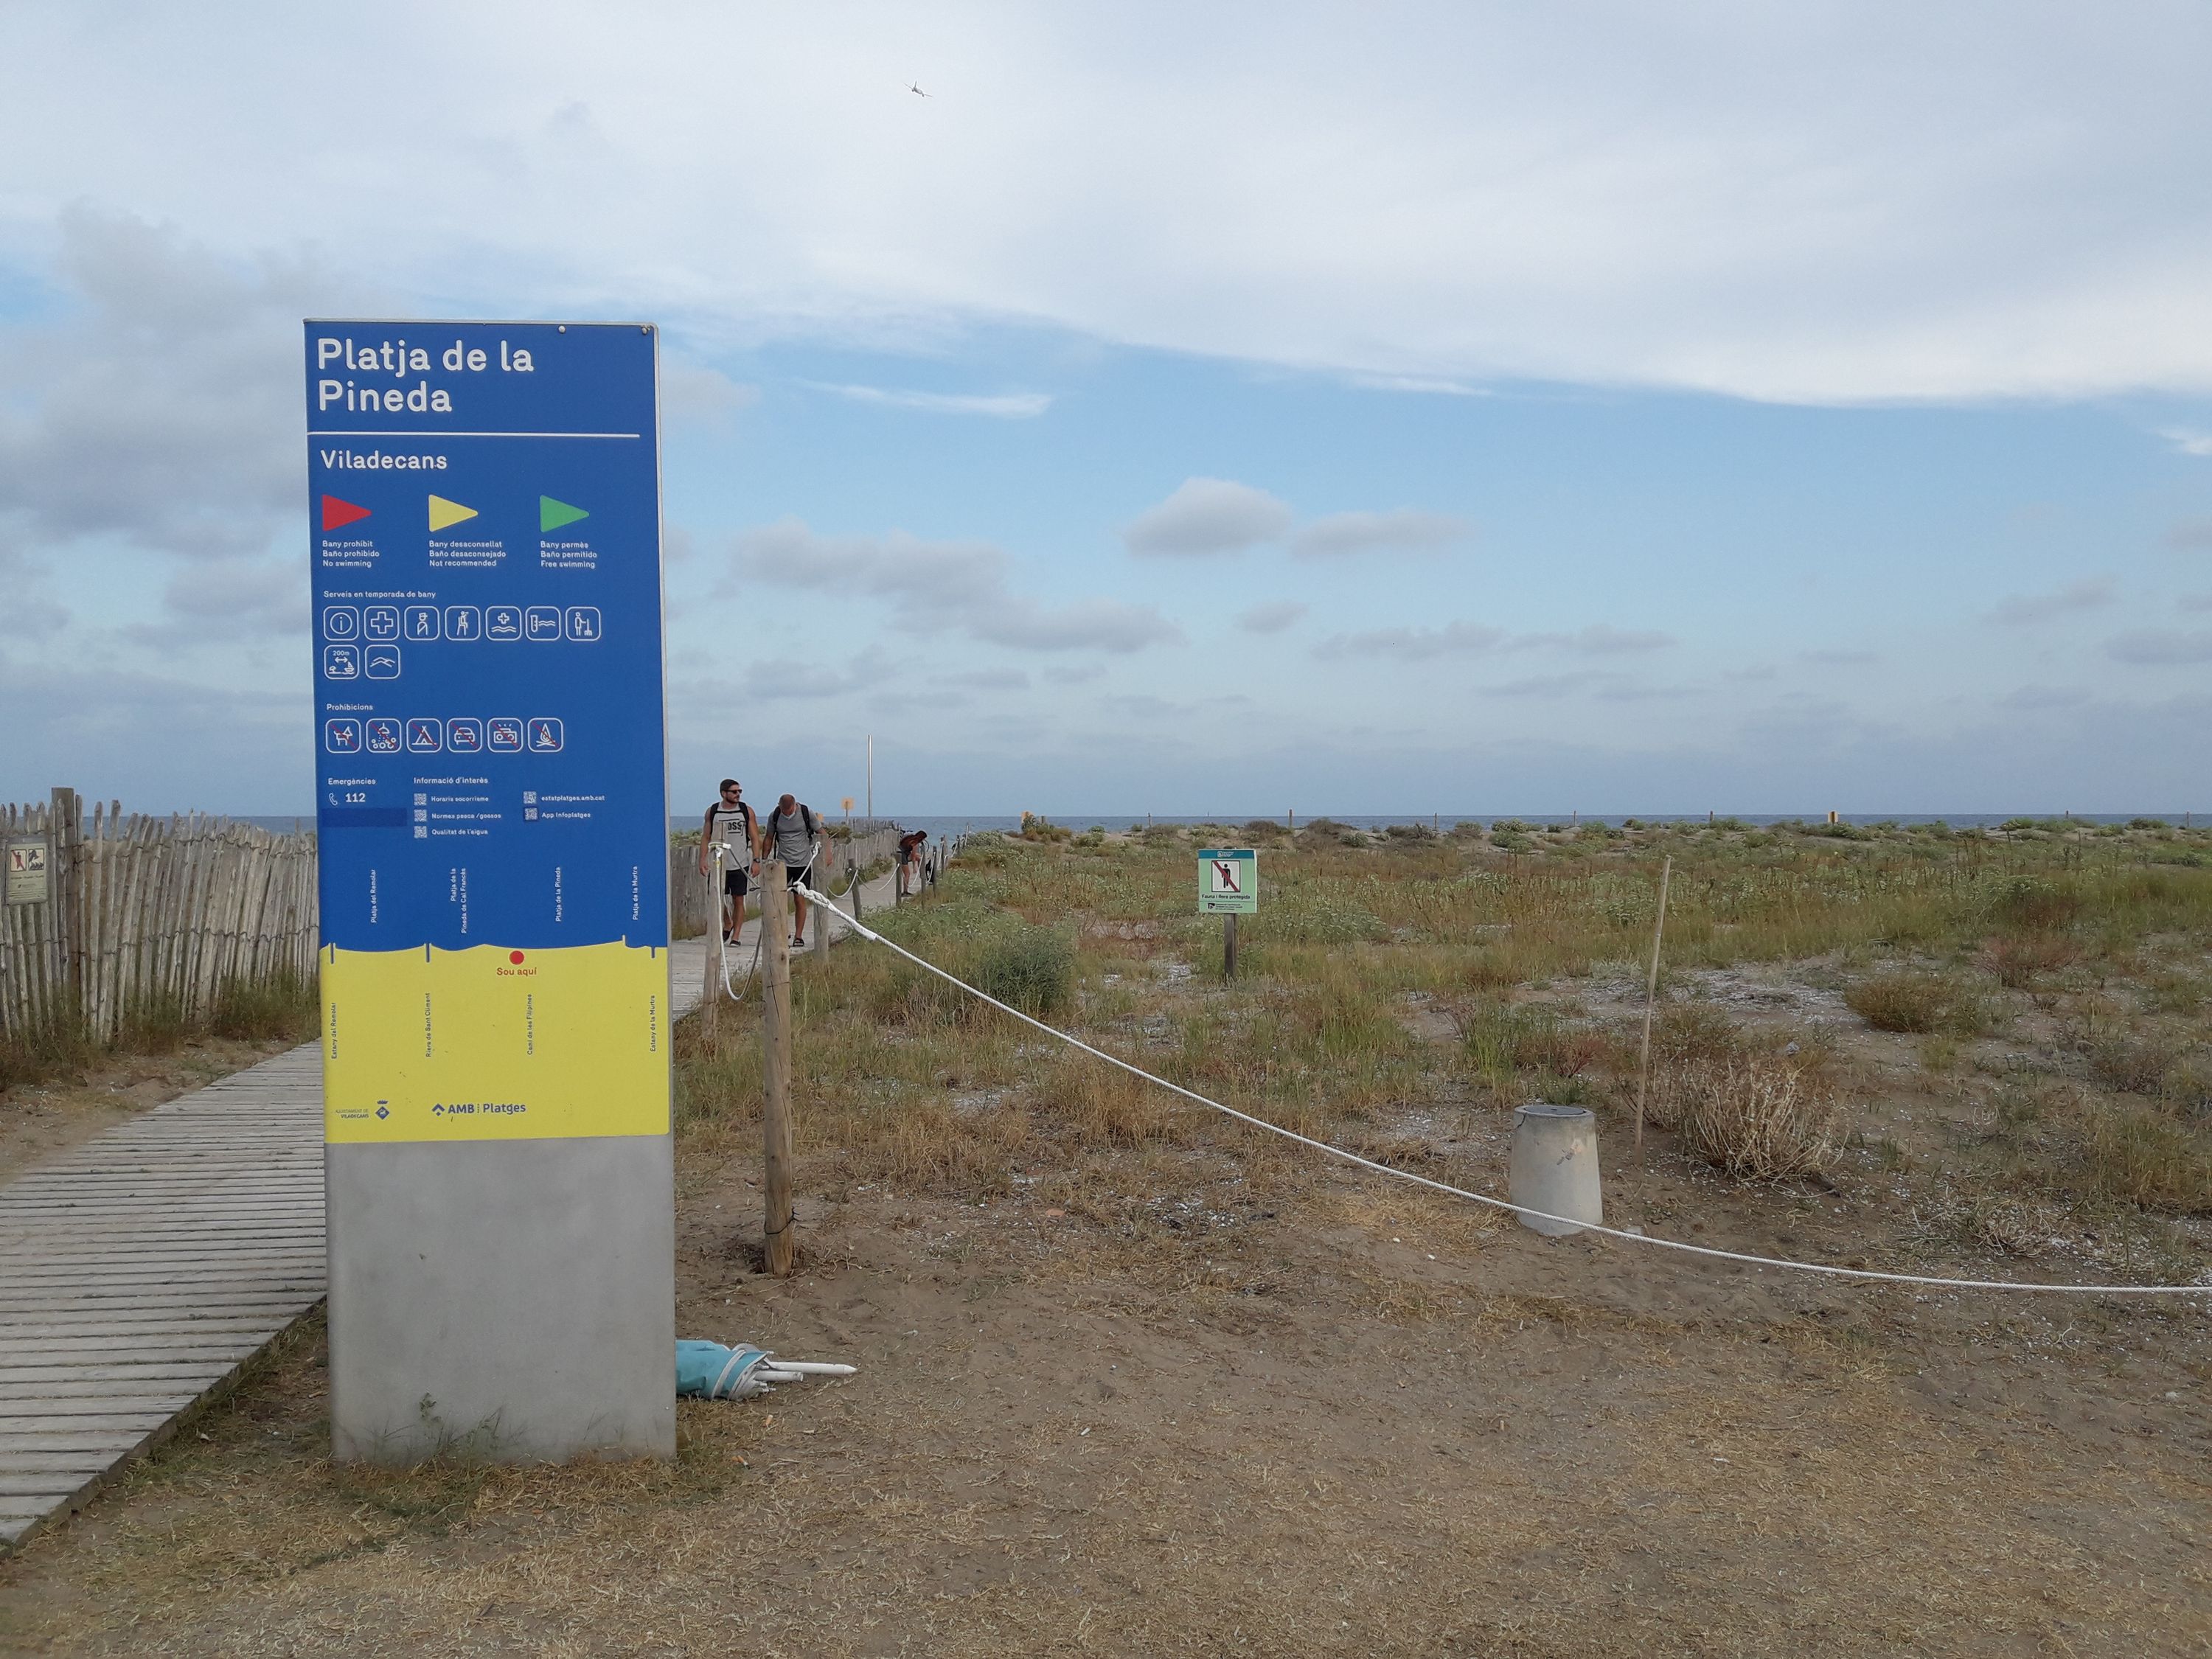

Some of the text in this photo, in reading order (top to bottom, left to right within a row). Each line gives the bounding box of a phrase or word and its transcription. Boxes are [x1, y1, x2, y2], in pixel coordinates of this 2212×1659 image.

[317, 338, 534, 378] Platja de la
[319, 380, 453, 412] Pineda
[320, 450, 448, 470] Viladecans
[322, 540, 373, 549] Bany prohibit
[429, 540, 448, 549] Bany
[540, 540, 588, 549] Bany permès
[322, 549, 380, 558] Baño prohibido
[451, 550, 507, 559] desaconsejado
[562, 551, 597, 560] permitido
[335, 560, 372, 568] swimming
[540, 560, 595, 569] Free swimming
[365, 591, 405, 599] temporada
[417, 591, 436, 599] bany
[327, 703, 373, 712] Prohibicions
[328, 777, 376, 786] Emergències
[455, 776, 488, 785] d'interès
[345, 793, 366, 803] 112
[541, 794, 605, 802] estatplatges.amb.cat
[451, 875, 456, 883] de
[555, 895, 561, 903] de
[460, 904, 467, 912] de
[496, 967, 537, 977] Sou aquí
[650, 1023, 655, 1031] de
[425, 1032, 431, 1040] de
[526, 1031, 532, 1039] de
[448, 1103, 526, 1115] AMB Platges
